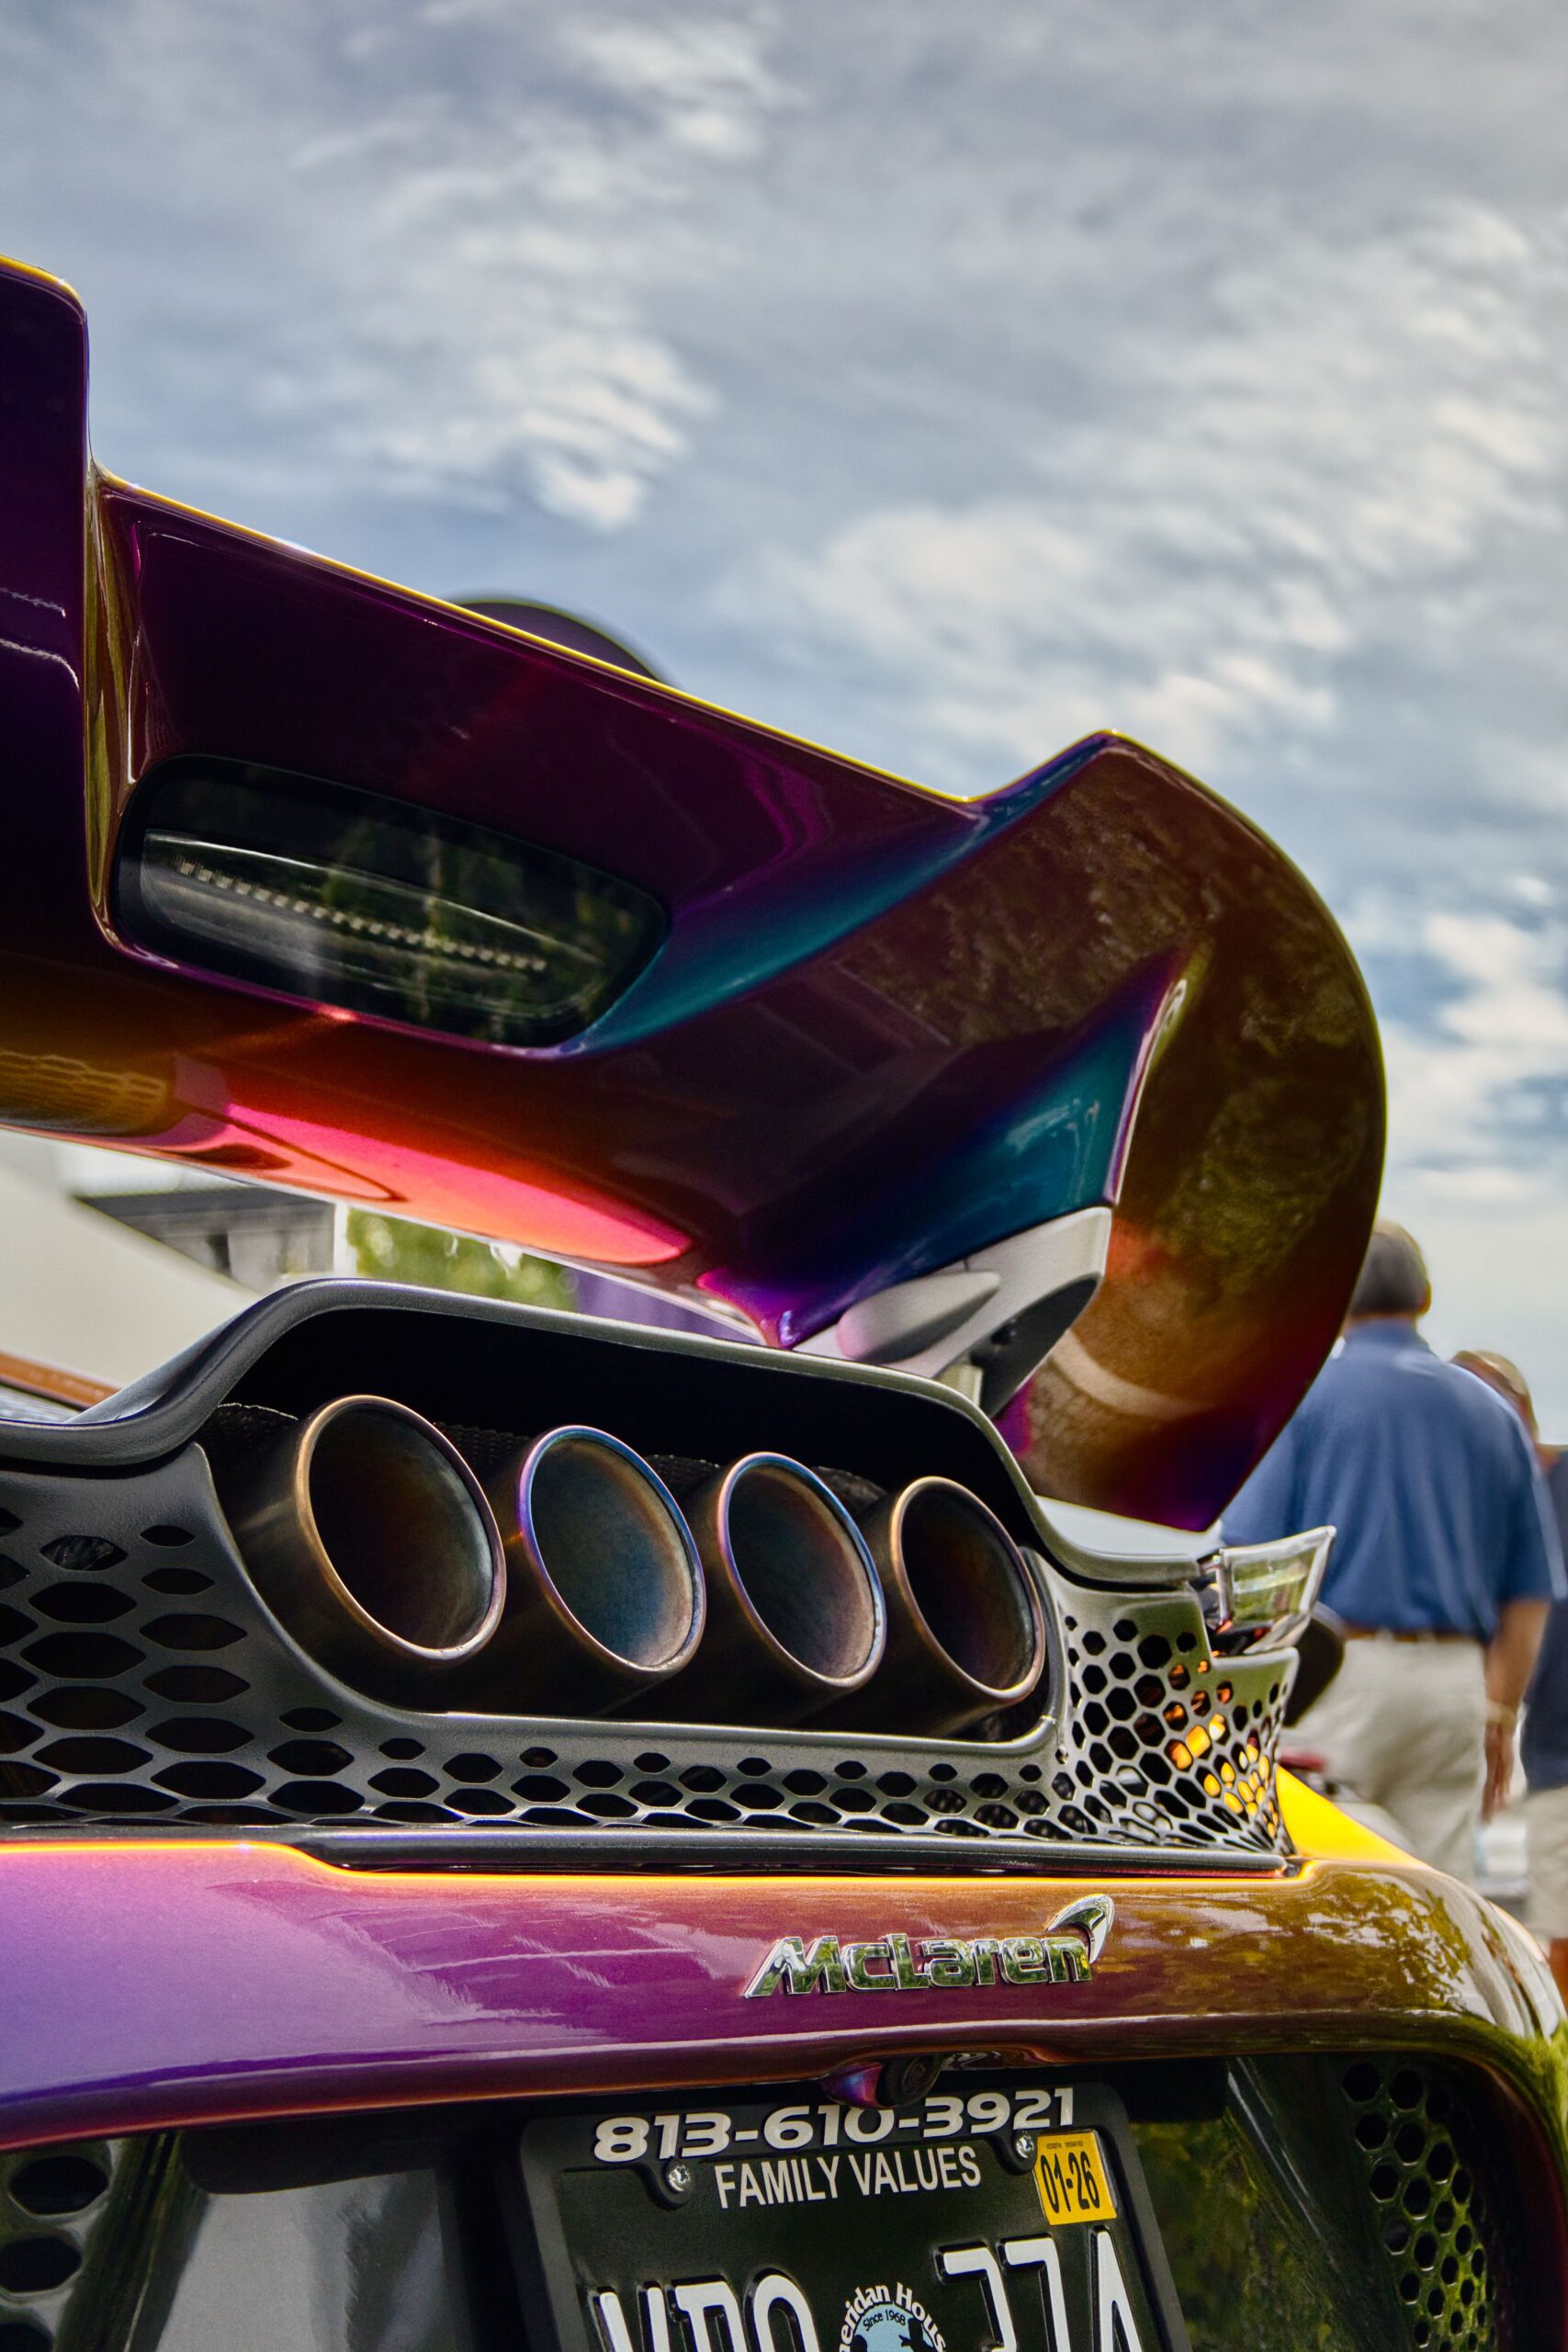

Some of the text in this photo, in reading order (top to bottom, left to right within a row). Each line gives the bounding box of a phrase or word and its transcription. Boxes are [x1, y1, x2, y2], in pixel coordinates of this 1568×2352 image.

[742, 1934, 1092, 1997] McLaren
[593, 2087, 1074, 2163] 813-610-3921
[714, 2145, 982, 2209] FAMILY VALUES
[1040, 2151, 1100, 2214] 01-26
[863, 2308, 907, 2332] Since 1968
